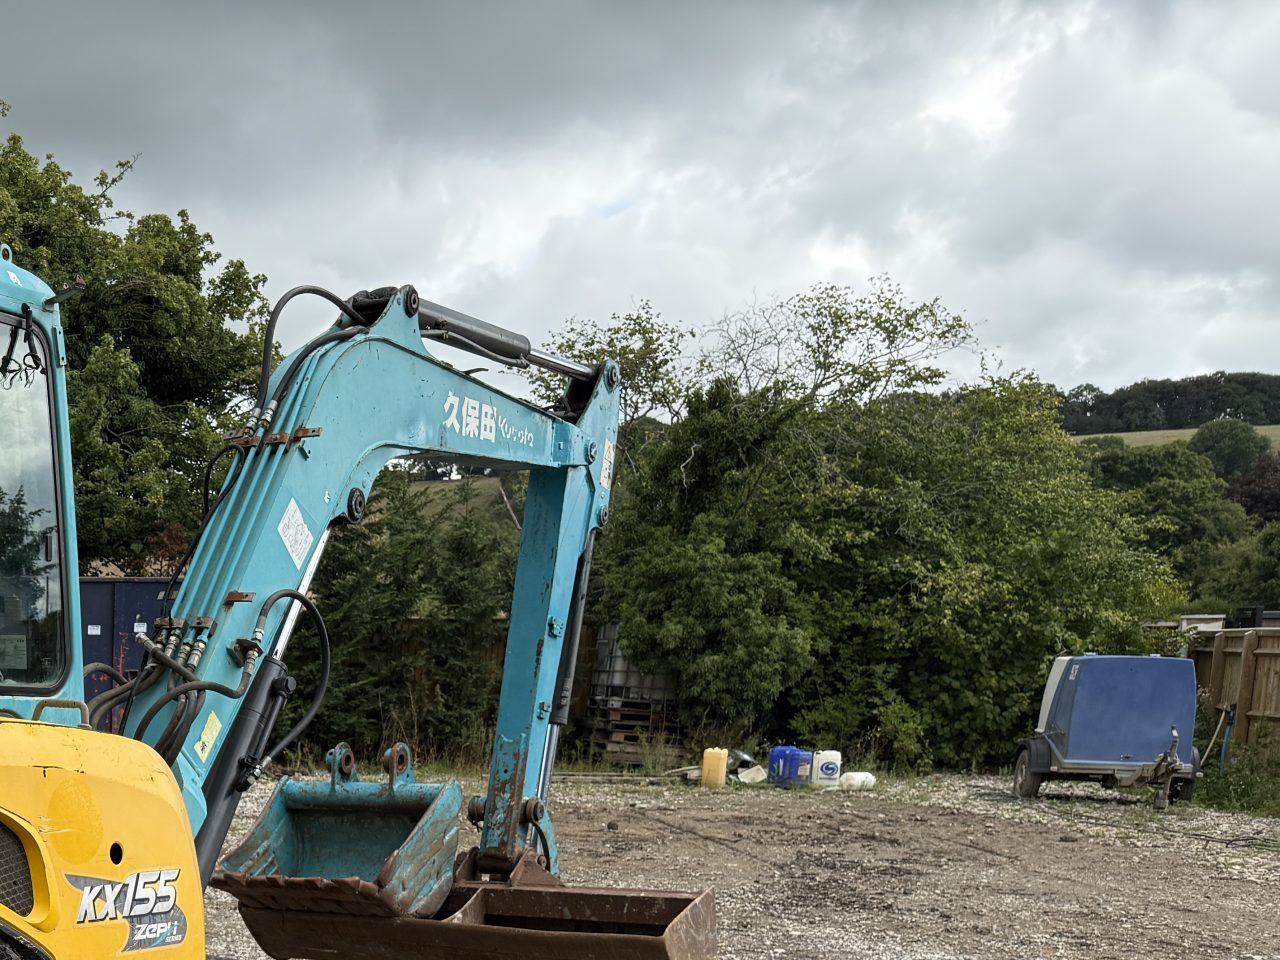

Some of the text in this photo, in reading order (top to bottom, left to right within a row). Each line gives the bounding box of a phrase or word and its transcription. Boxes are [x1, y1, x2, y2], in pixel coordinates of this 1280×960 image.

[442, 390, 497, 444] 久保田
[77, 869, 180, 924] KX155
[164, 934, 183, 943] SERIES
